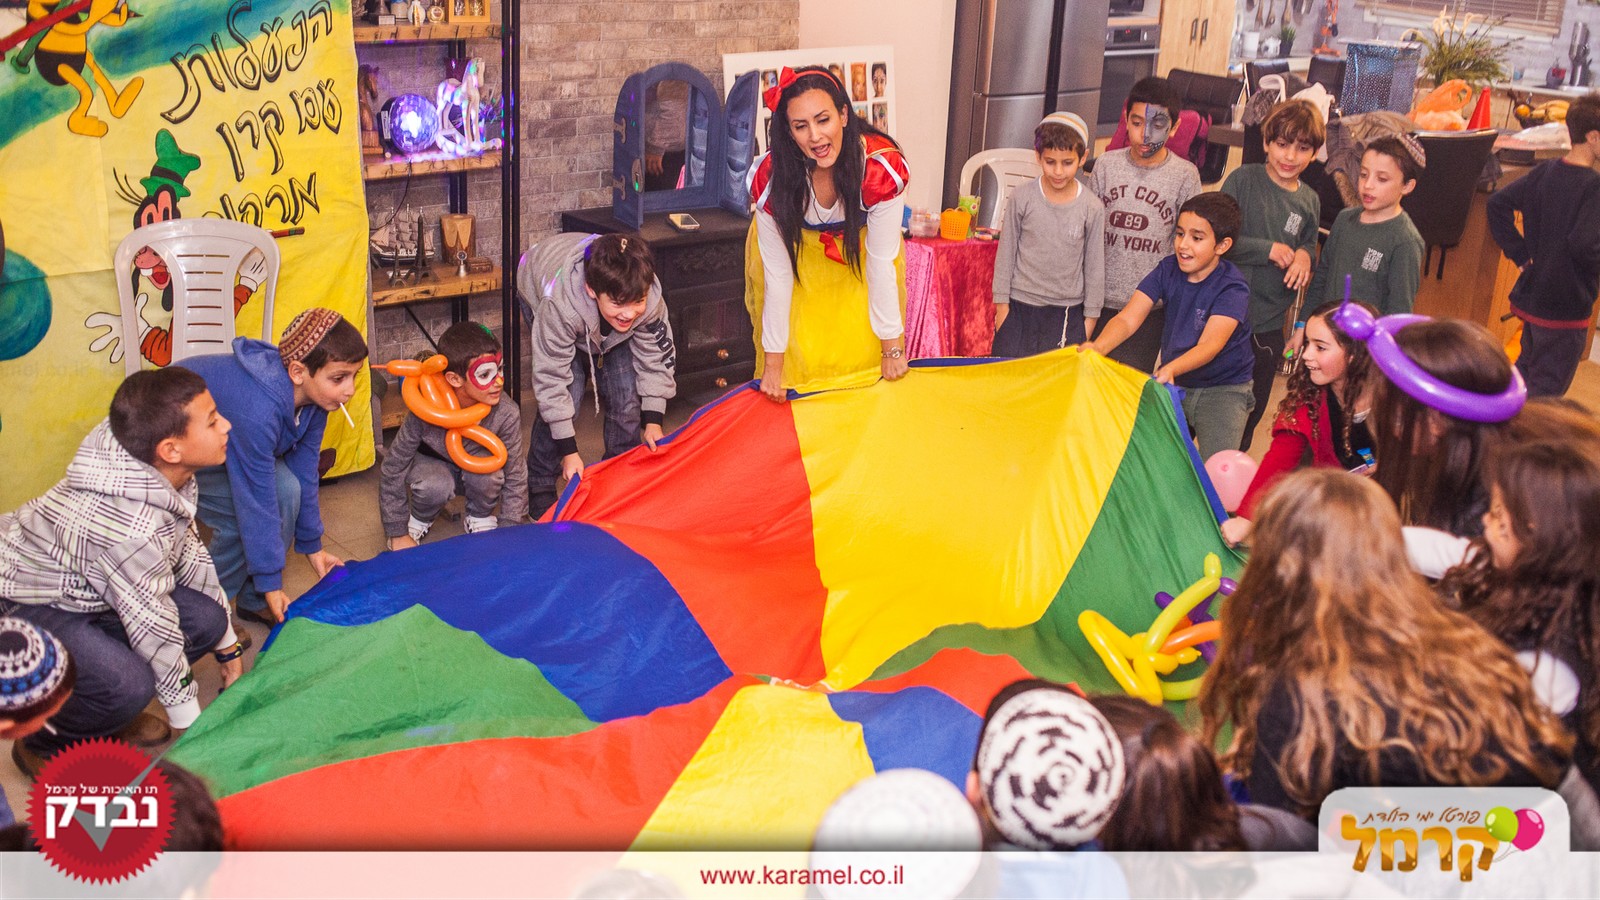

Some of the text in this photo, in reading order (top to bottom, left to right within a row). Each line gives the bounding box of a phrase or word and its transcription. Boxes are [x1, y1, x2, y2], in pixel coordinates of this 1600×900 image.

[215, 100, 285, 182] קרן
[1098, 185, 1174, 226] AST COAST
[1113, 212, 1143, 228] F 89
[1123, 235, 1161, 253] YORK
